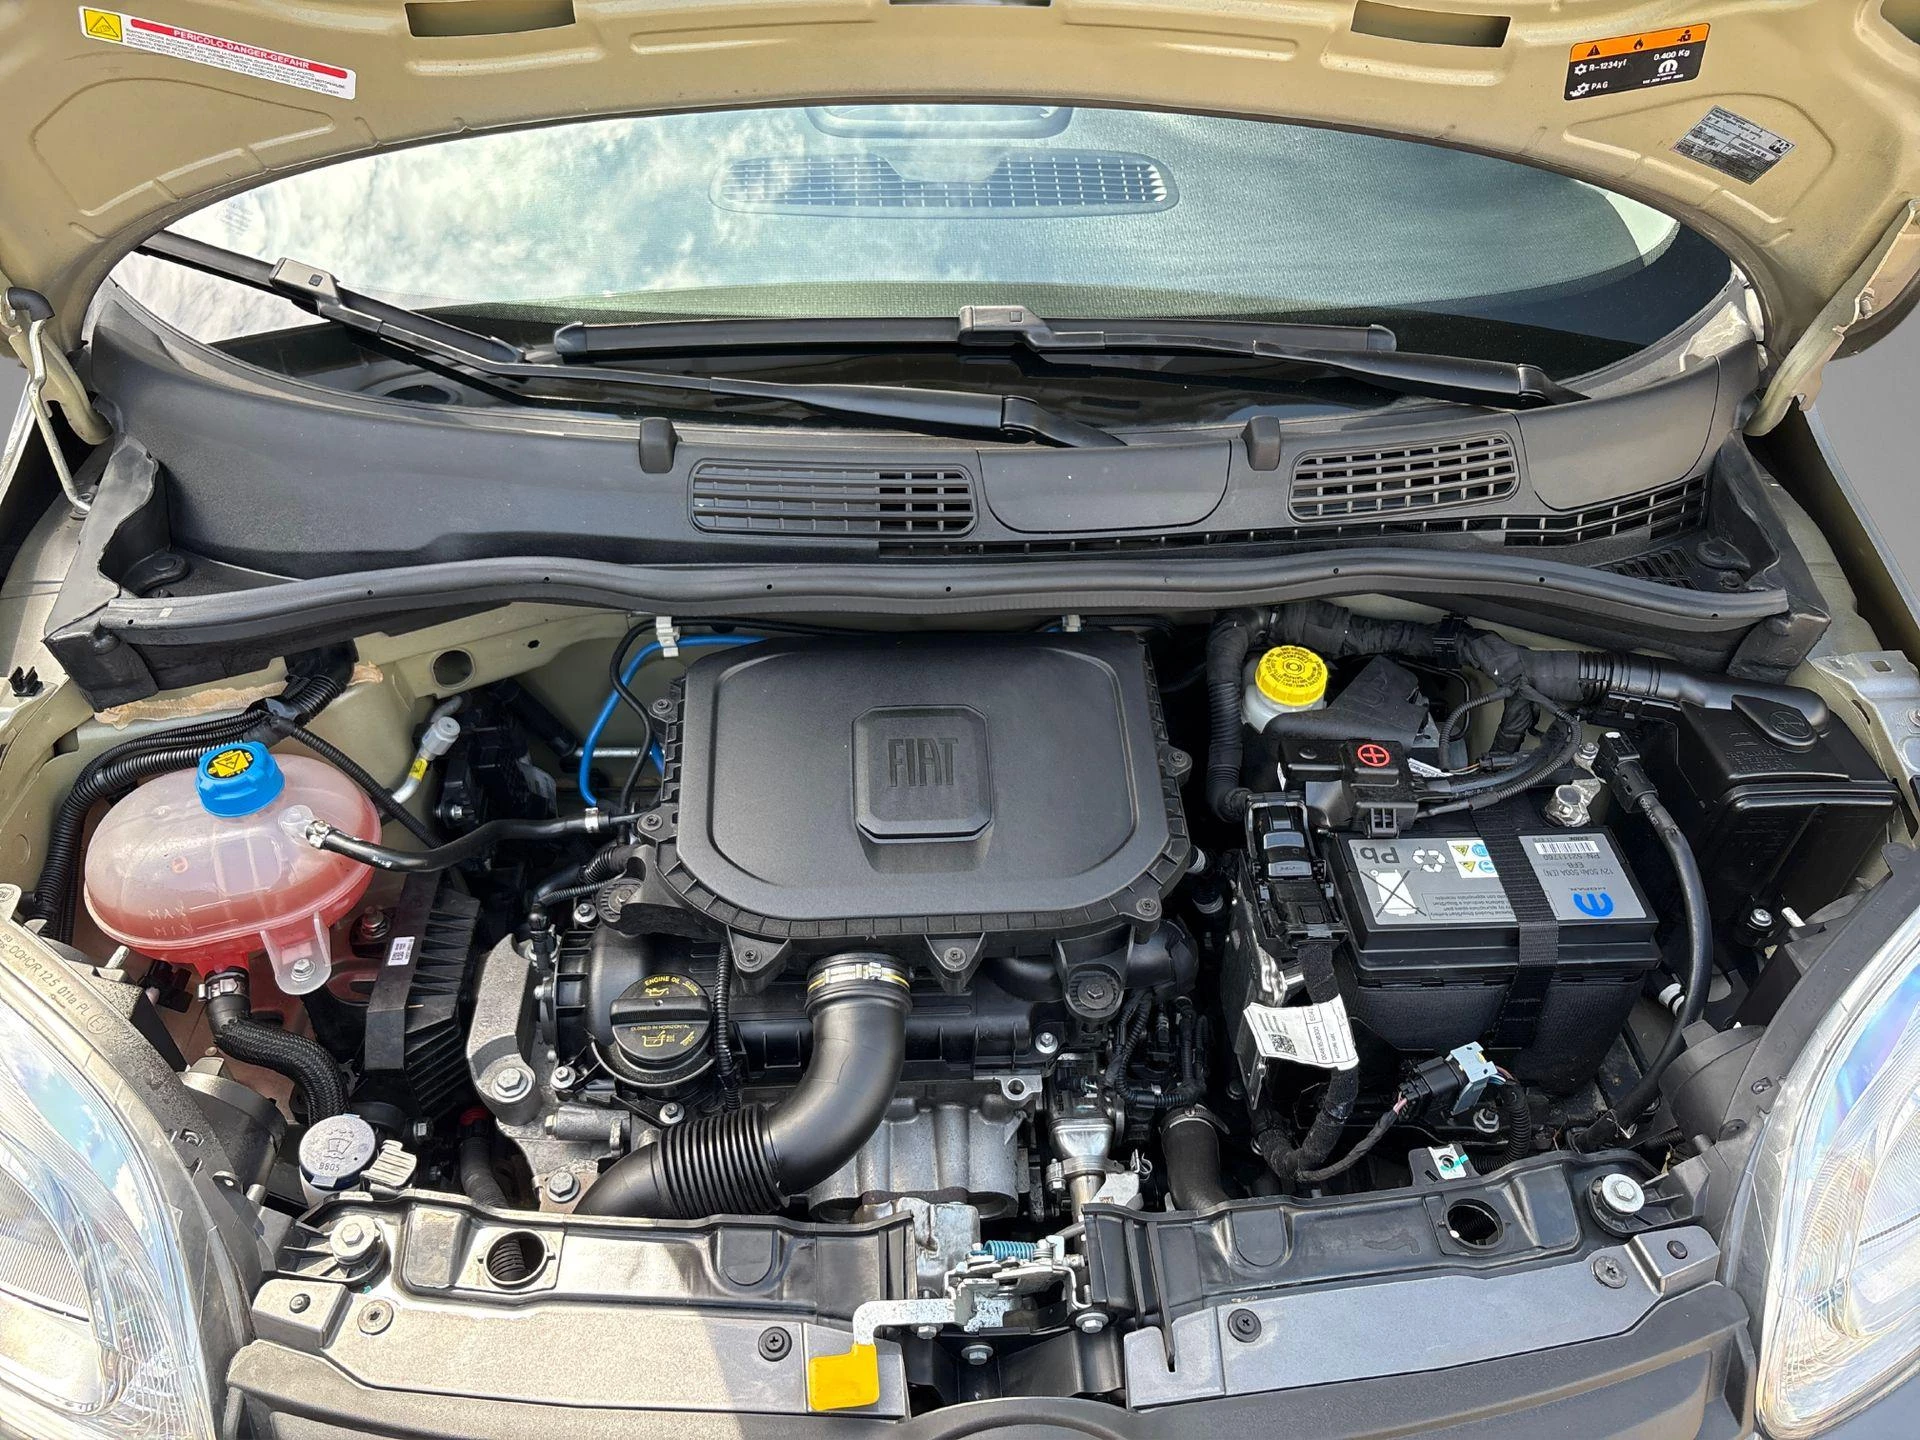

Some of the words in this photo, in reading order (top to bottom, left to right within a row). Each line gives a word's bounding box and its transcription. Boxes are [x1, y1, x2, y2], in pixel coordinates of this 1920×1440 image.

[173, 29, 310, 69] PERICOLO-DANGER-GEFAHR
[1653, 51, 1676, 61] 0.400
[1678, 49, 1690, 58] Kg
[1588, 59, 1627, 71] R-1234yf
[1591, 81, 1608, 90] PAG
[887, 738, 958, 787] FIAT
[1360, 846, 1400, 864] Pb
[644, 976, 670, 986] ENGINE
